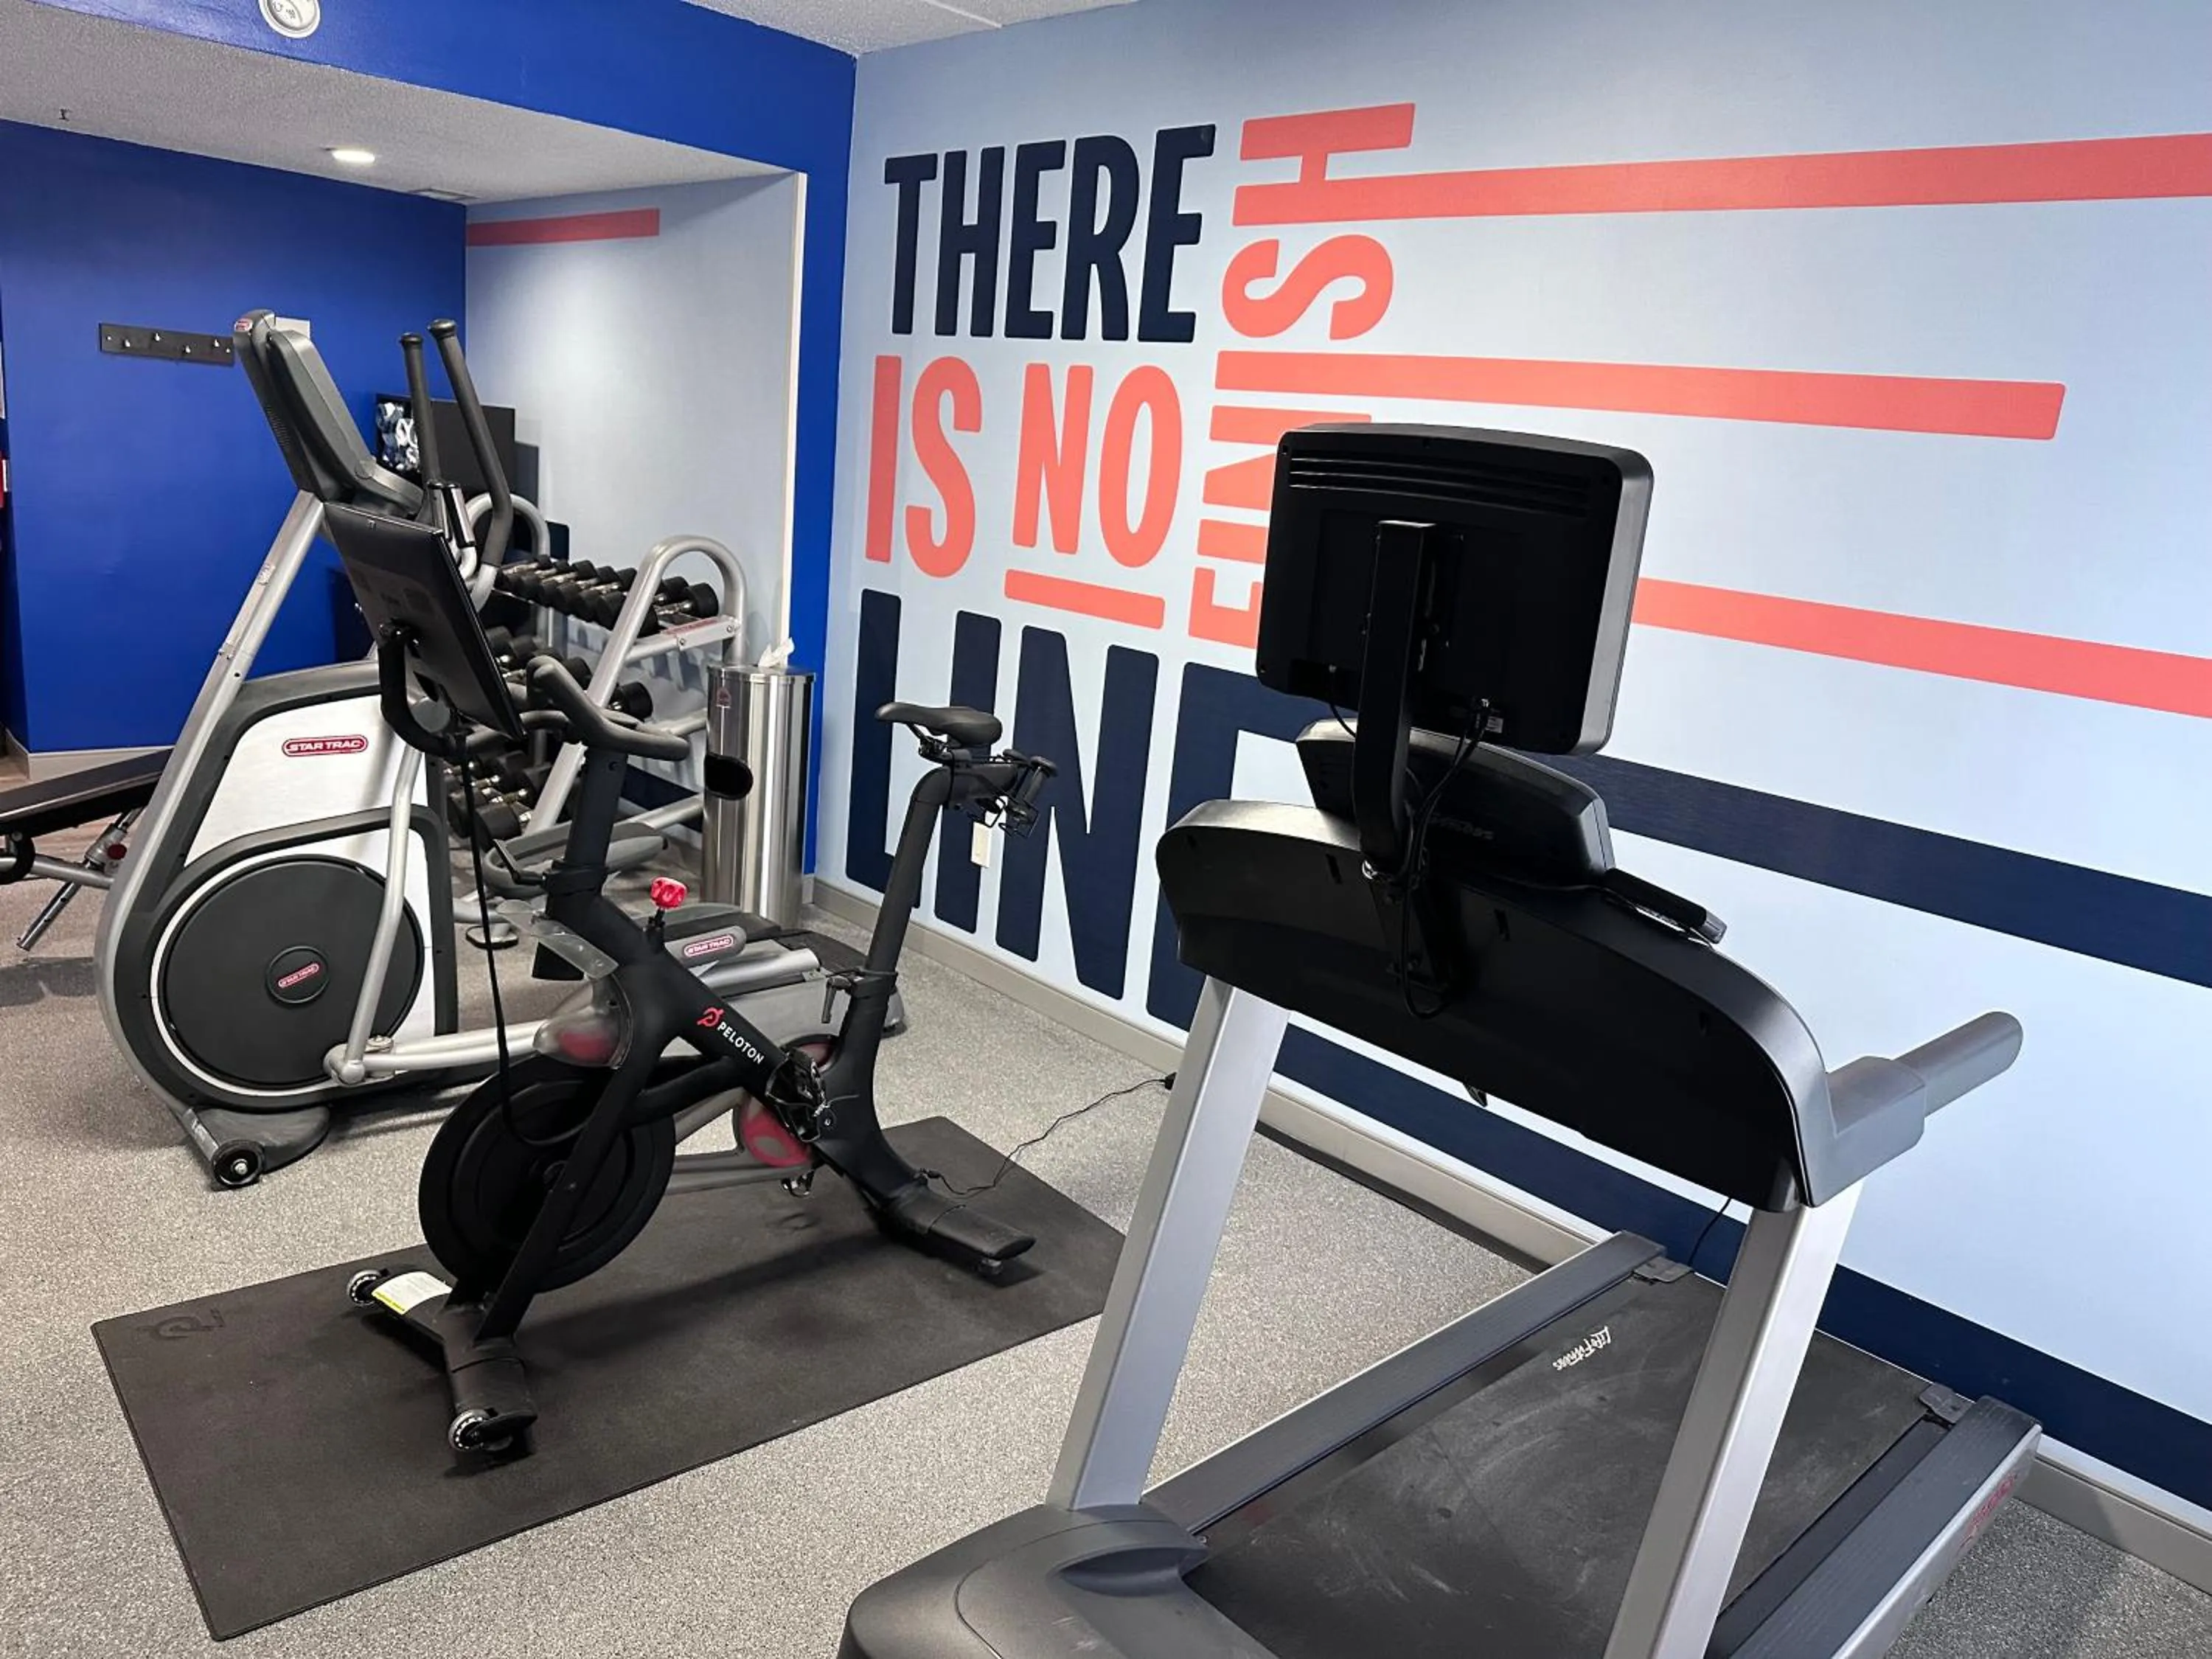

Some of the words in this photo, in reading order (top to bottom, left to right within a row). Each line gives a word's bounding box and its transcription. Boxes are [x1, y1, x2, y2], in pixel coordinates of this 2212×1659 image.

[885, 124, 1216, 343] THERE
[866, 355, 982, 578] IS
[1012, 363, 1183, 568] NO
[288, 742, 324, 752] STAR
[324, 740, 362, 750] TRAC
[717, 1021, 765, 1064] PELOTON
